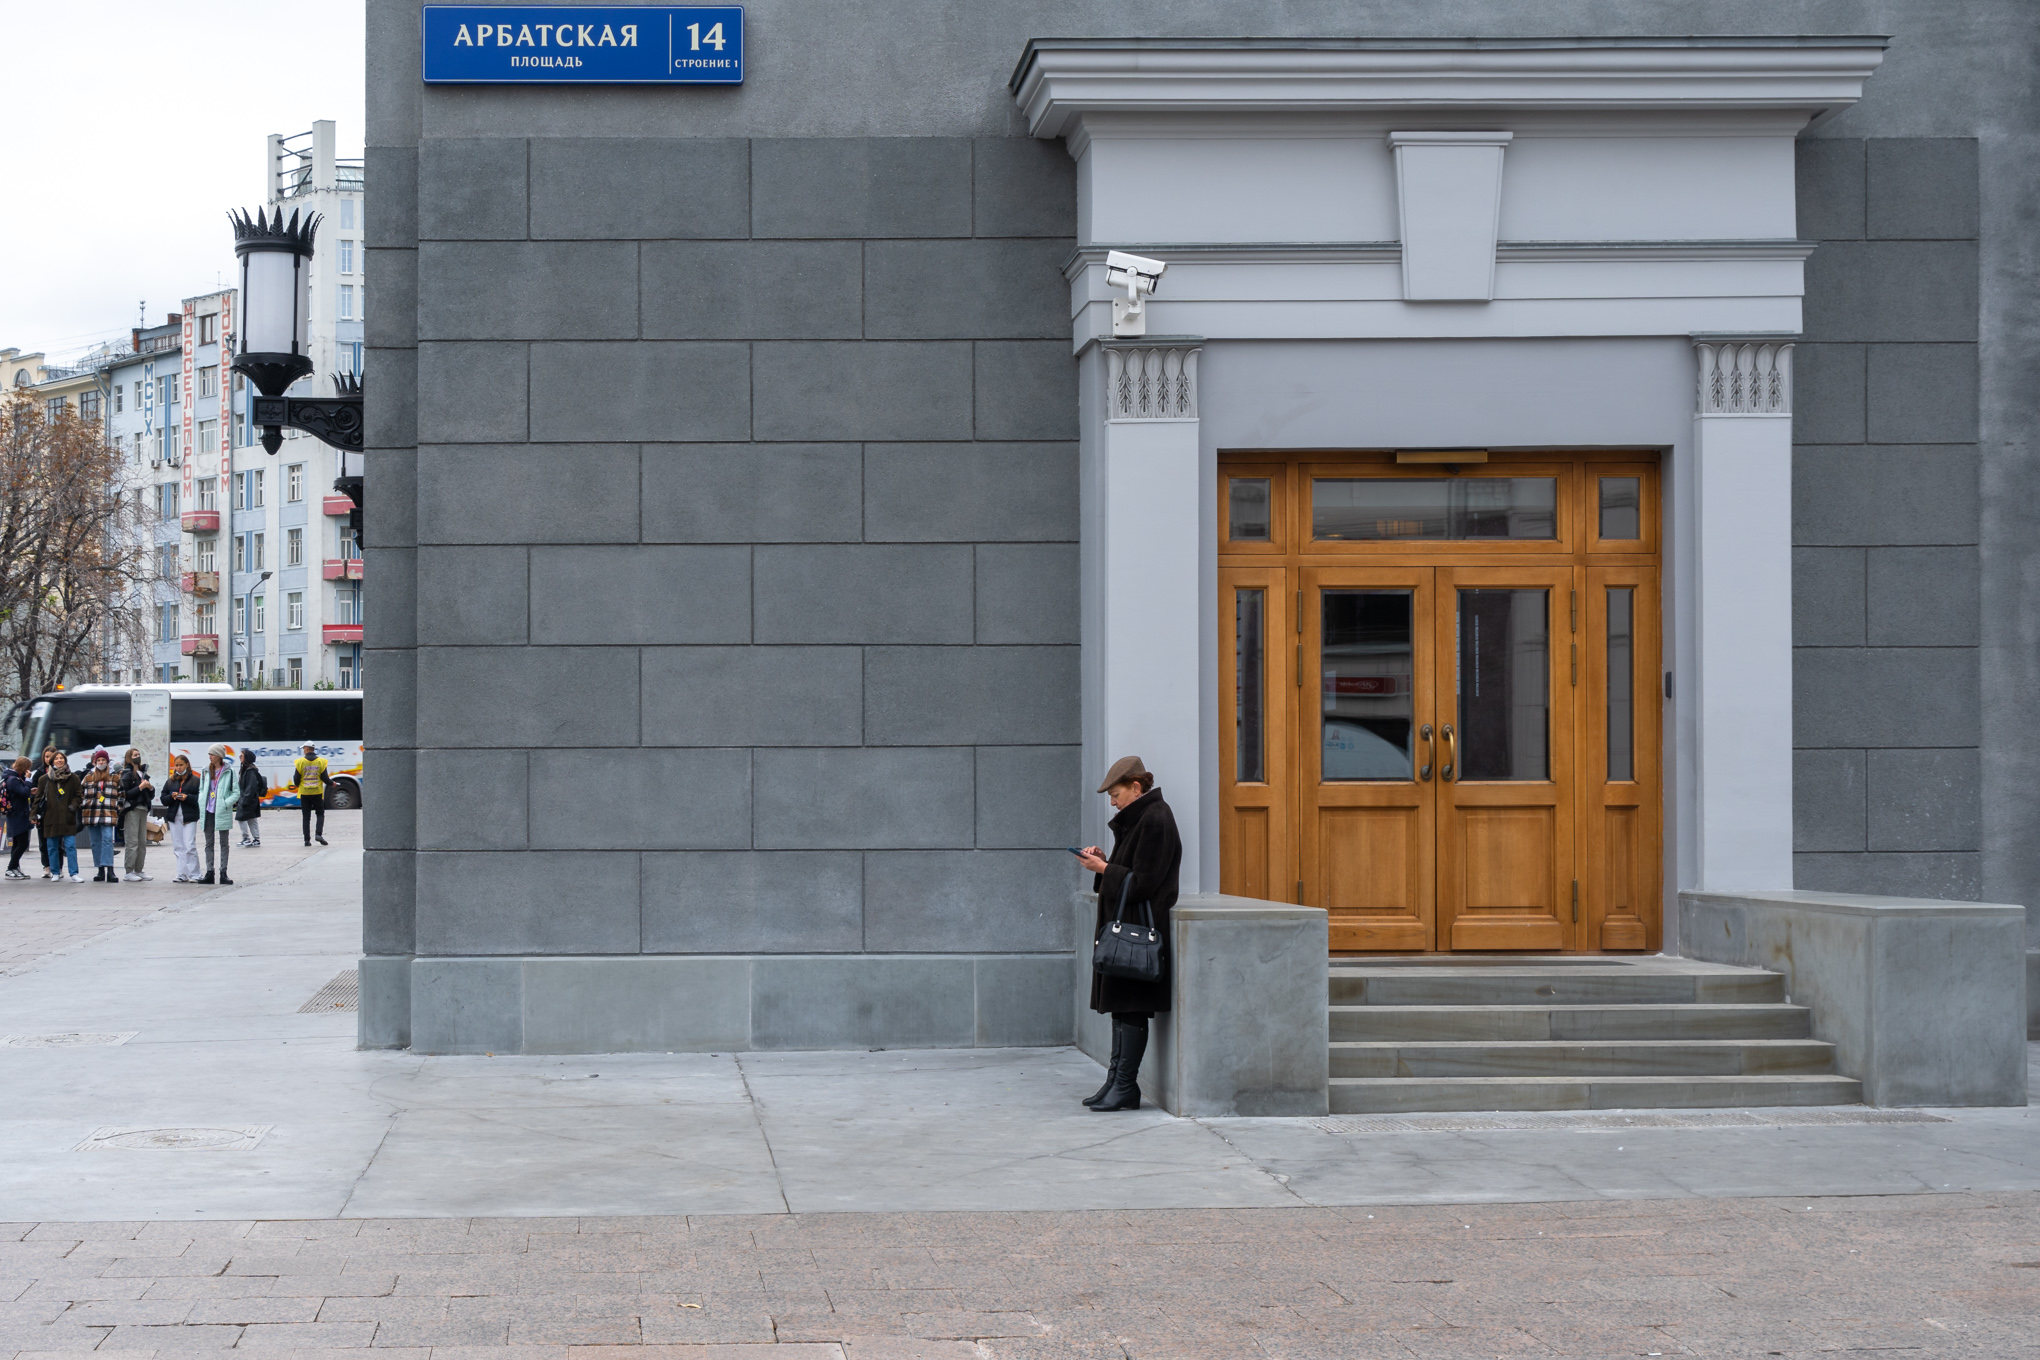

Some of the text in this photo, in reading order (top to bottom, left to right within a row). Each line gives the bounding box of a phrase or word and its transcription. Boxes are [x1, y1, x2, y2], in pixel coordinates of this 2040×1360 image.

[453, 24, 638, 47] АРБАТСКАЯ
[686, 22, 726, 51] 14
[510, 56, 583, 68] ПЛОЩАДЬ
[674, 59, 738, 68] СТРОЕНИЕ 1
[144, 363, 154, 437] МСНХ
[183, 303, 193, 498] МОССЕЛЬПРОМ
[221, 294, 231, 493] МОССЕЛЬПРОМ
